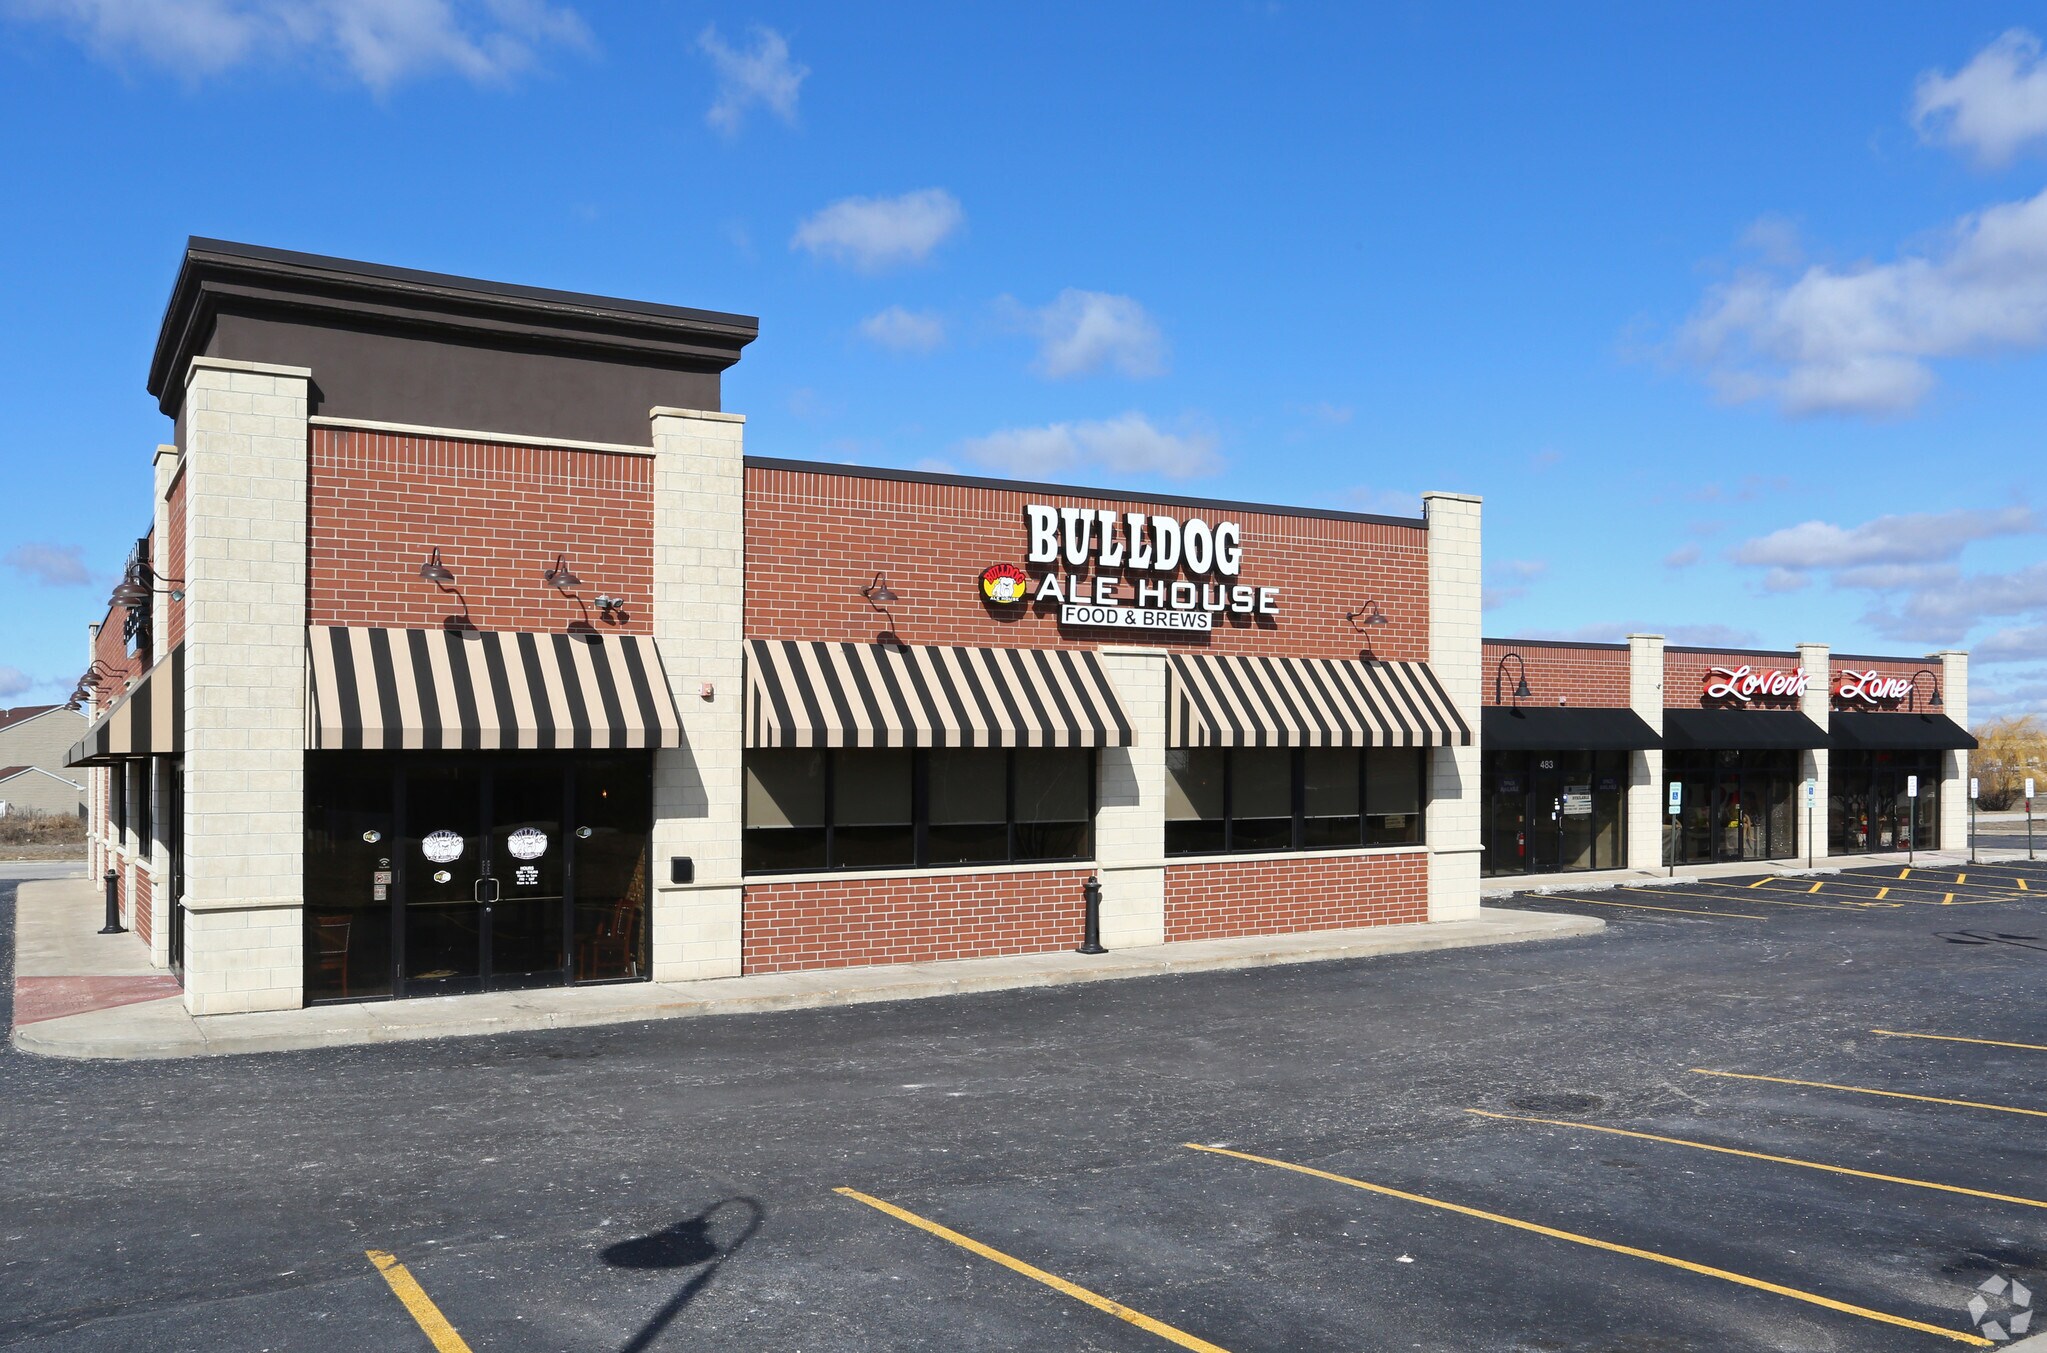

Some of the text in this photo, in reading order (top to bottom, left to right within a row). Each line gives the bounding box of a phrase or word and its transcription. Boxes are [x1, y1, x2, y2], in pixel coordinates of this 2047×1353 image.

[1025, 504, 1243, 576] BULLDOG
[983, 563, 1026, 586] BULLDOG
[1036, 573, 1281, 615] ALE HOUSE
[1065, 607, 1209, 629] FOOD & BREWS
[1706, 664, 1914, 704] Lover's Lane
[1540, 760, 1554, 769] 483
